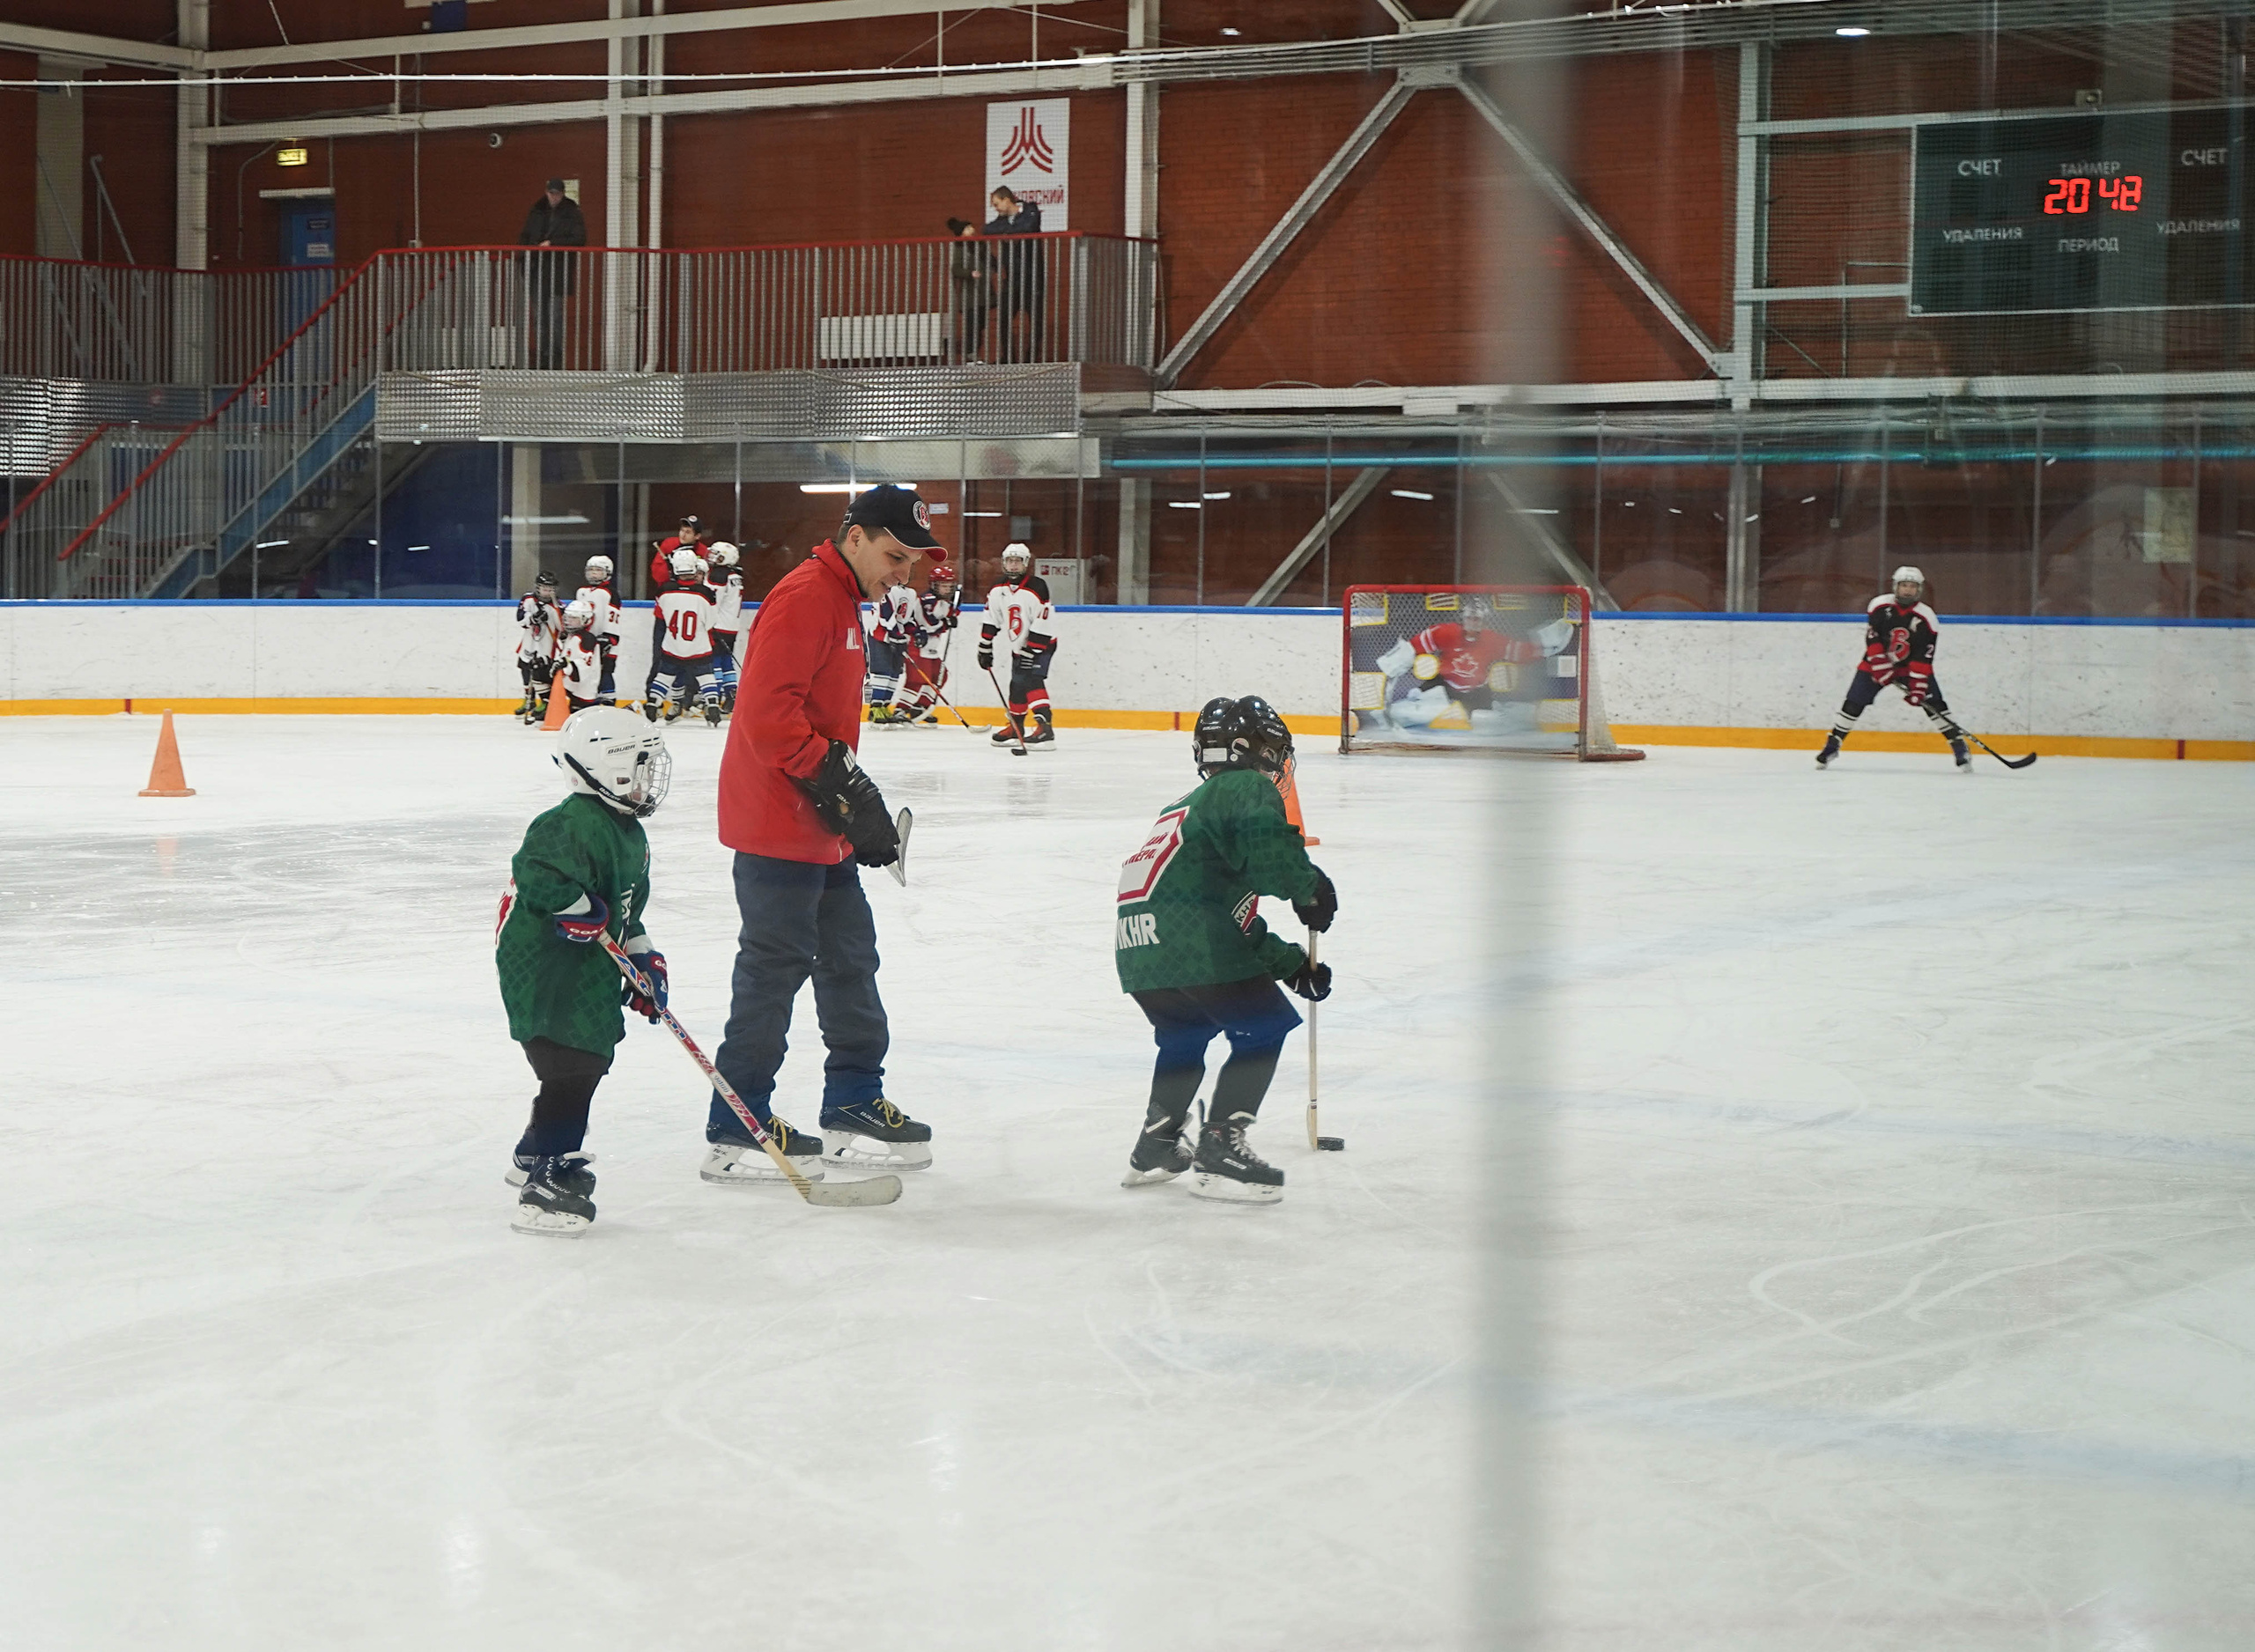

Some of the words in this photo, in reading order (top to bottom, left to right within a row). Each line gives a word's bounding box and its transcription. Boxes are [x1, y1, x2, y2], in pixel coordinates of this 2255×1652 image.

[2180, 147, 2229, 166] СЧЕТ
[1957, 159, 2002, 176] СЧЕТ
[2059, 159, 2122, 176] ТАЙМЕР
[2043, 178, 2091, 215] 20
[1942, 225, 2023, 243] УДАЛЕНИЯ
[2156, 217, 2241, 236] УДАЛЕНИЯ
[2058, 236, 2120, 254] ПЕРИОД
[668, 610, 698, 641] 40
[607, 745, 636, 755] BAUER
[860, 1110, 887, 1128] BAUER
